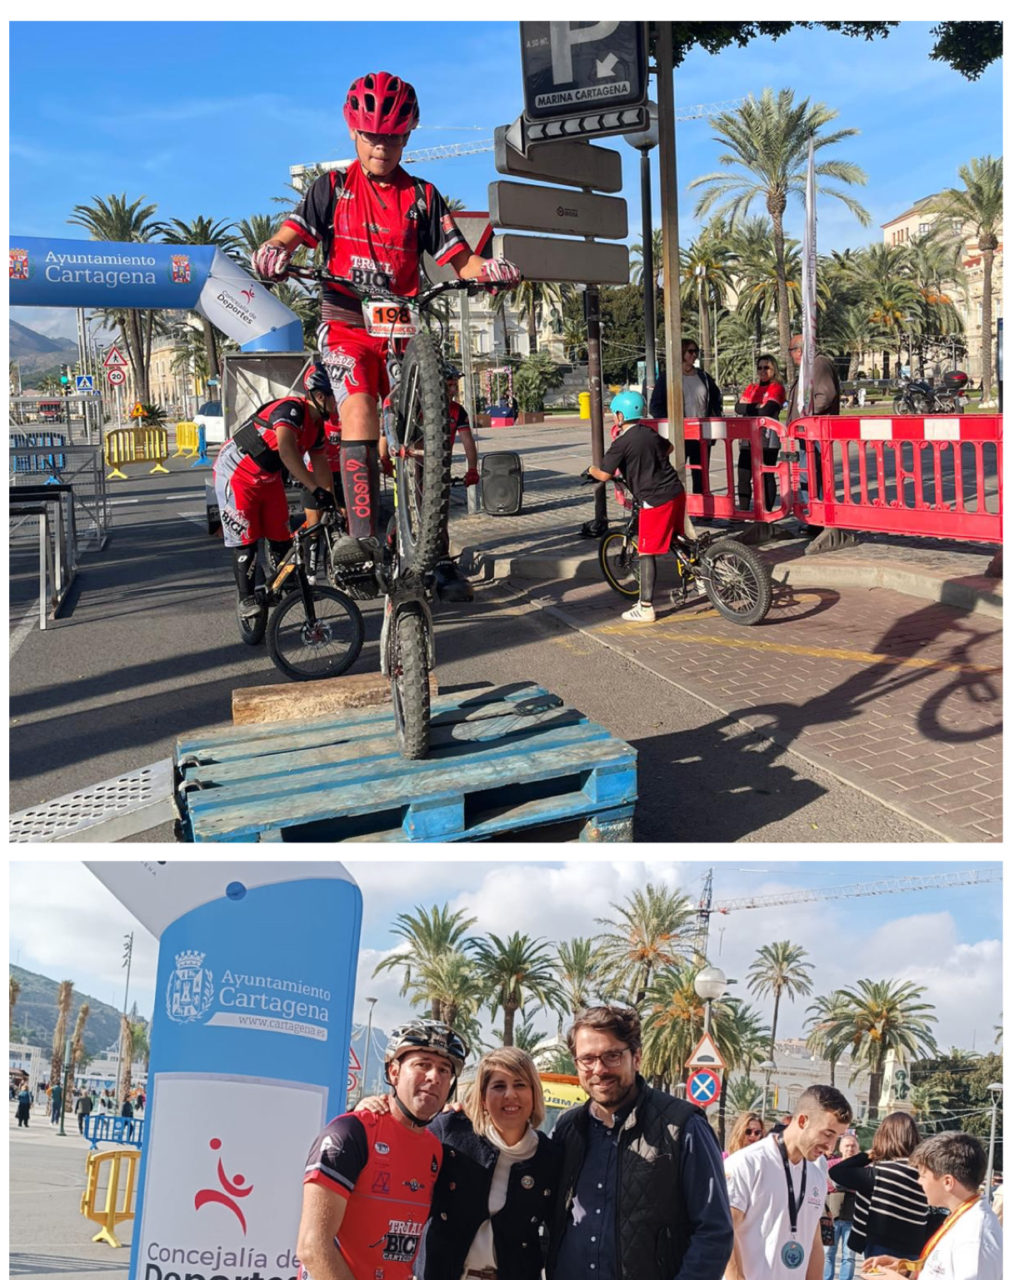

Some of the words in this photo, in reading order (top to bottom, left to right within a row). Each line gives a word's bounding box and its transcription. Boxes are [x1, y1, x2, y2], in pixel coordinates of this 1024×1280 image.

[537, 93, 573, 106] MARINA
[575, 85, 628, 100] CARTAGENA
[45, 251, 156, 266] Ayuntamiento
[45, 265, 156, 288] Cartagena
[217, 293, 253, 325] Deportes
[376, 307, 410, 323] 198
[221, 969, 331, 1001] Ayuntamiento
[219, 987, 329, 1022] Cartagena
[238, 1015, 326, 1038] www.cartagena.es
[388, 1219, 423, 1236] TRIAL
[147, 1242, 268, 1272] Concejalía
[276, 1249, 301, 1269] de
